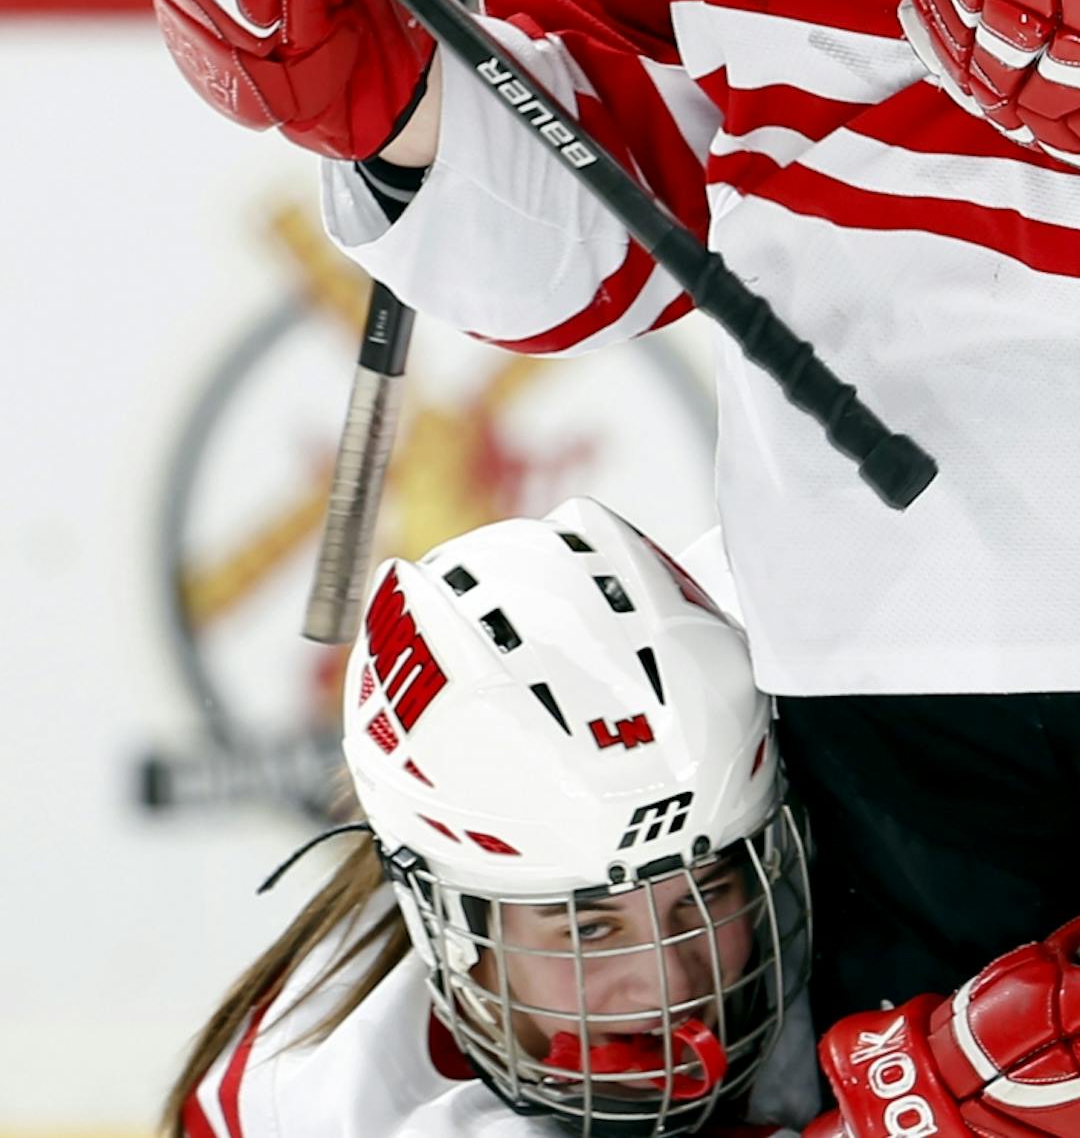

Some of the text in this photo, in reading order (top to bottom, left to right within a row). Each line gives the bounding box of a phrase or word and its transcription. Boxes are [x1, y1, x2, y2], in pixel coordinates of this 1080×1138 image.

[476, 57, 599, 168] BAUER
[365, 560, 450, 734] NORTH
[587, 713, 655, 750] LN
